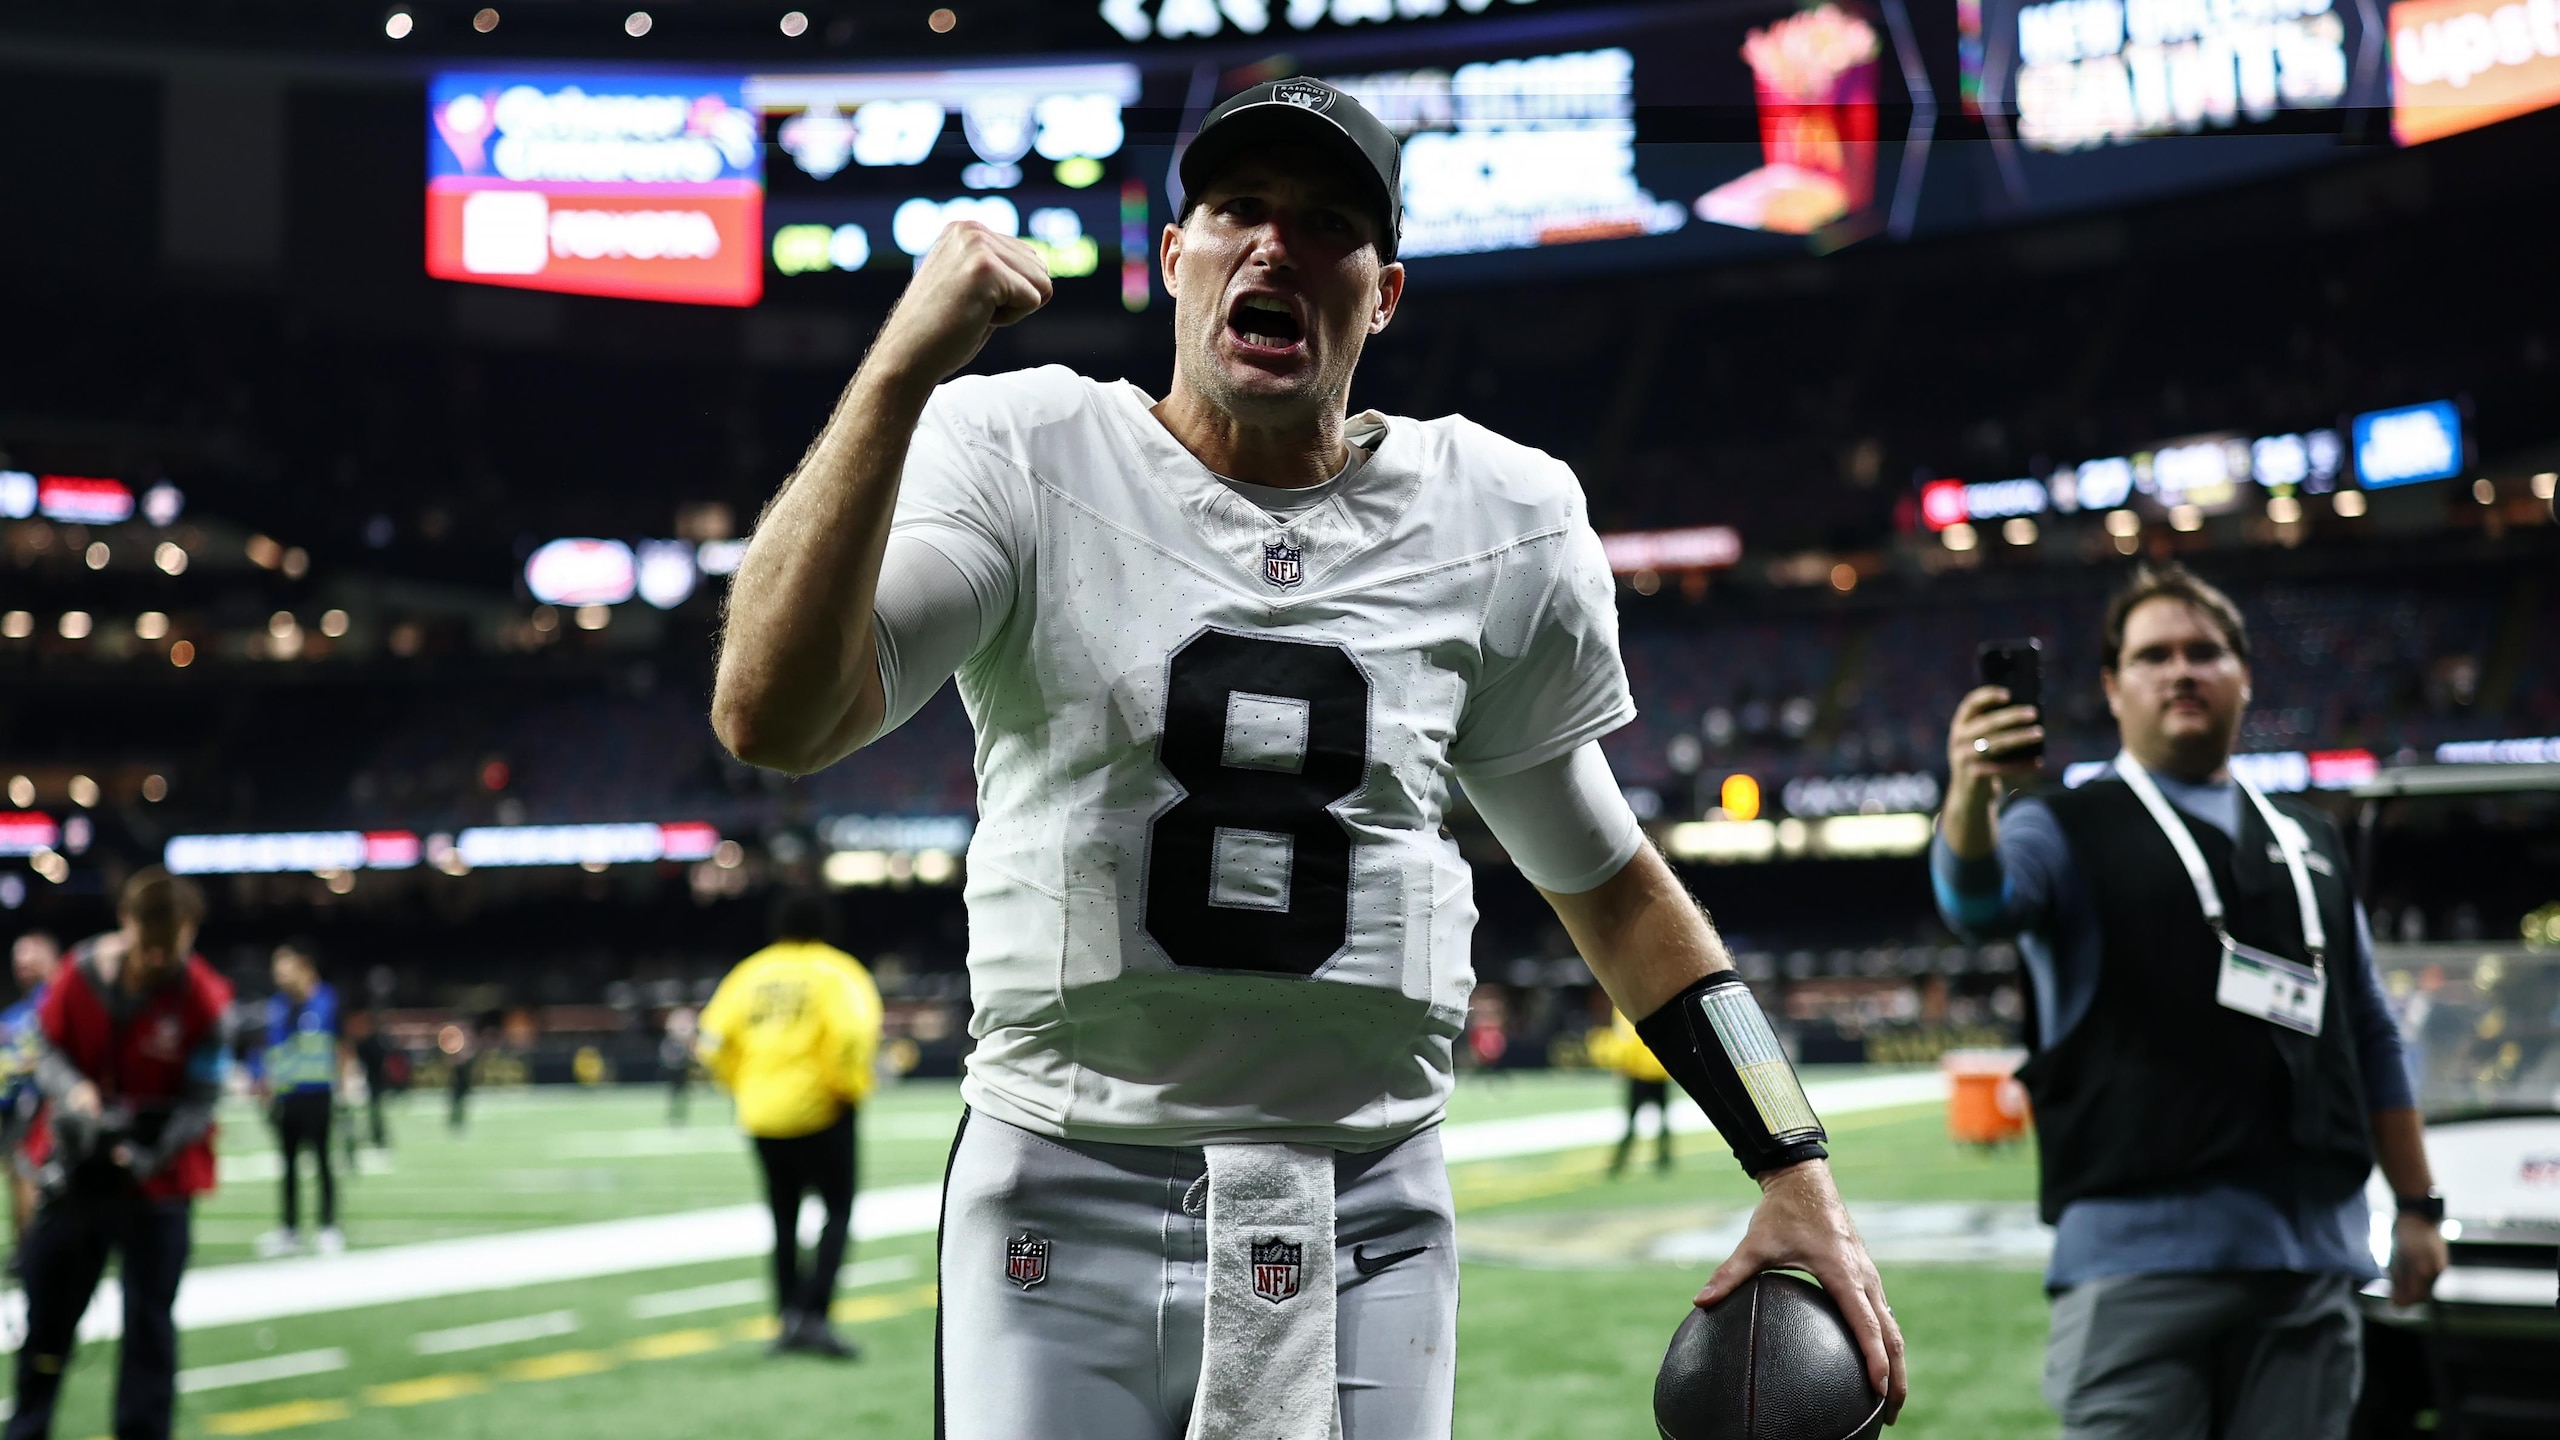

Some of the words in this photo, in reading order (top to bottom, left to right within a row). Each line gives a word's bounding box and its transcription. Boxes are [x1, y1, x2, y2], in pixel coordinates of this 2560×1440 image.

[1280, 85, 1325, 96] RAIDERS
[1269, 560, 1298, 581] NFL
[1137, 623, 1375, 981] 8
[1010, 1257, 1040, 1280] NFL
[1256, 1265, 1296, 1297] NFL
